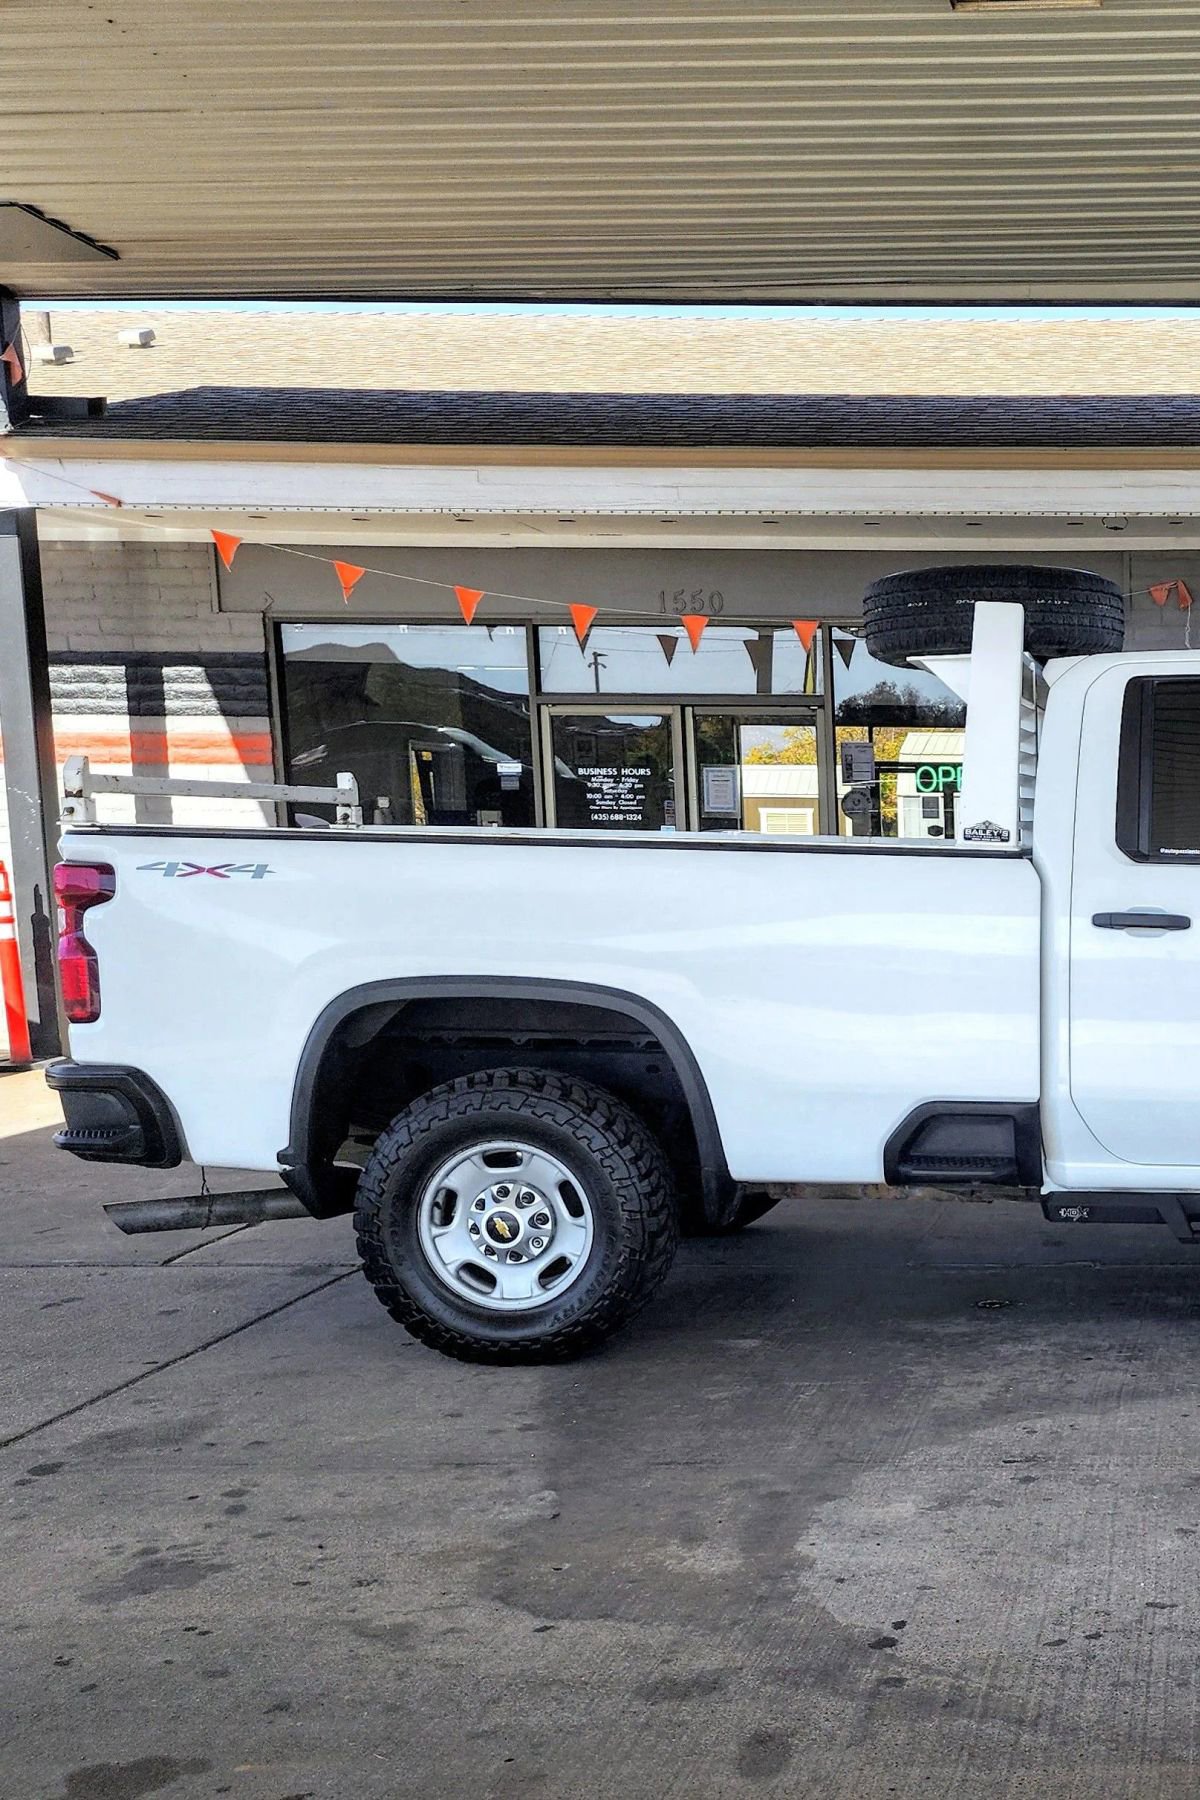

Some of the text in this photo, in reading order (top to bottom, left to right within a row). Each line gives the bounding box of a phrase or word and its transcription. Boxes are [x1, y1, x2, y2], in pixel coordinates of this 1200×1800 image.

[658, 588, 724, 614] 1550
[577, 767, 651, 776] BUSINESS HOURS
